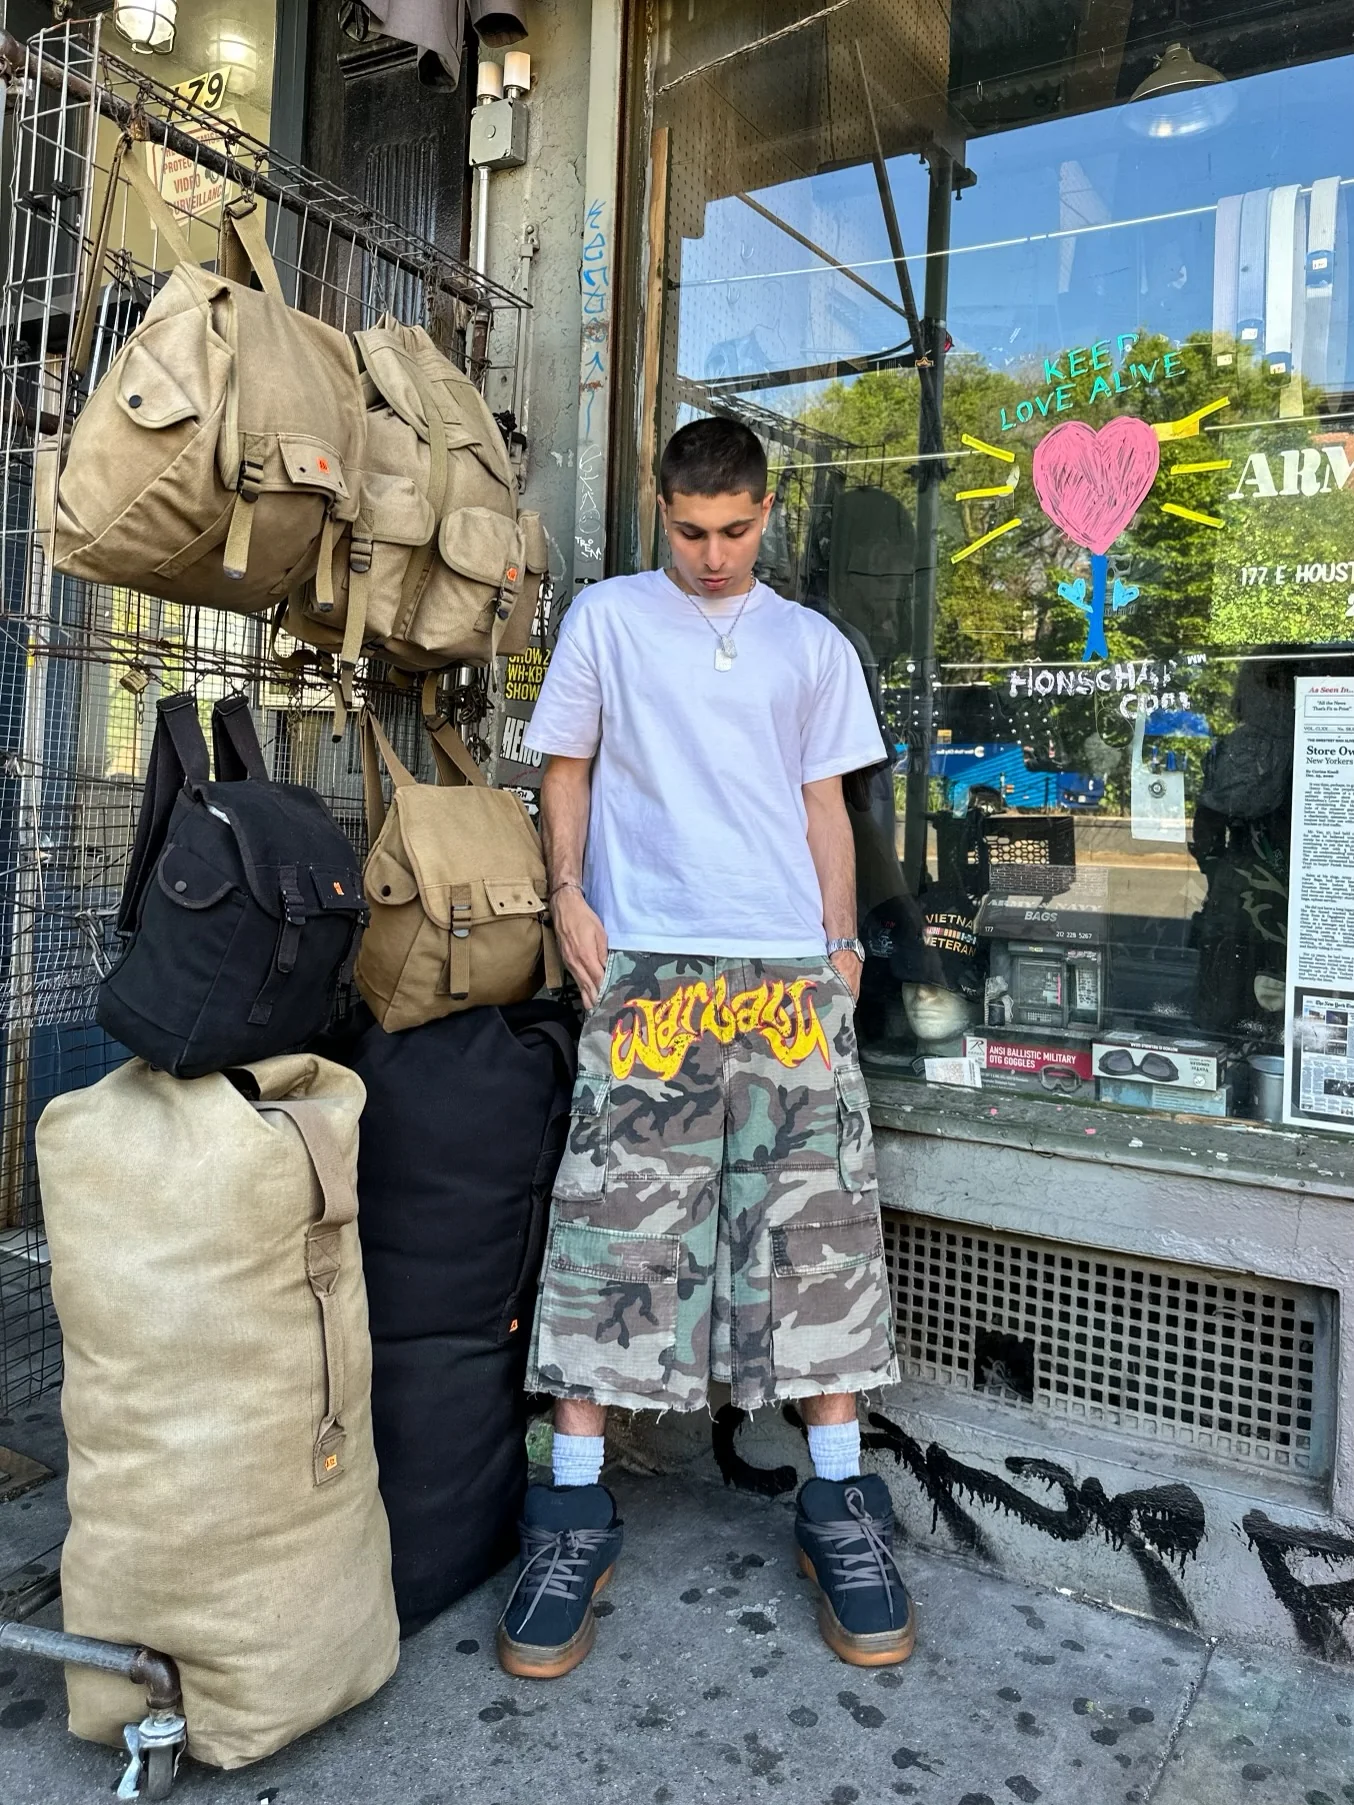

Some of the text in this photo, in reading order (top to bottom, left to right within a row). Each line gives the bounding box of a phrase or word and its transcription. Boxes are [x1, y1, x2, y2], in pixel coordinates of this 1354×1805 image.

[1043, 333, 1140, 386] KEEP
[1000, 350, 1187, 431] LOVE ALIVE
[1241, 566, 1268, 586] 177
[1275, 564, 1287, 585] E
[1306, 745, 1337, 756] Store
[1306, 757, 1354, 765] New Yorkers
[1024, 911, 1058, 922] BAGS
[923, 935, 977, 957] VETERAN
[989, 1046, 1006, 1056] ANSI
[1007, 1047, 1041, 1060] BALLISTIC
[1042, 1053, 1076, 1065] MILITARY
[989, 1056, 1036, 1069] OTG GOGGLES
